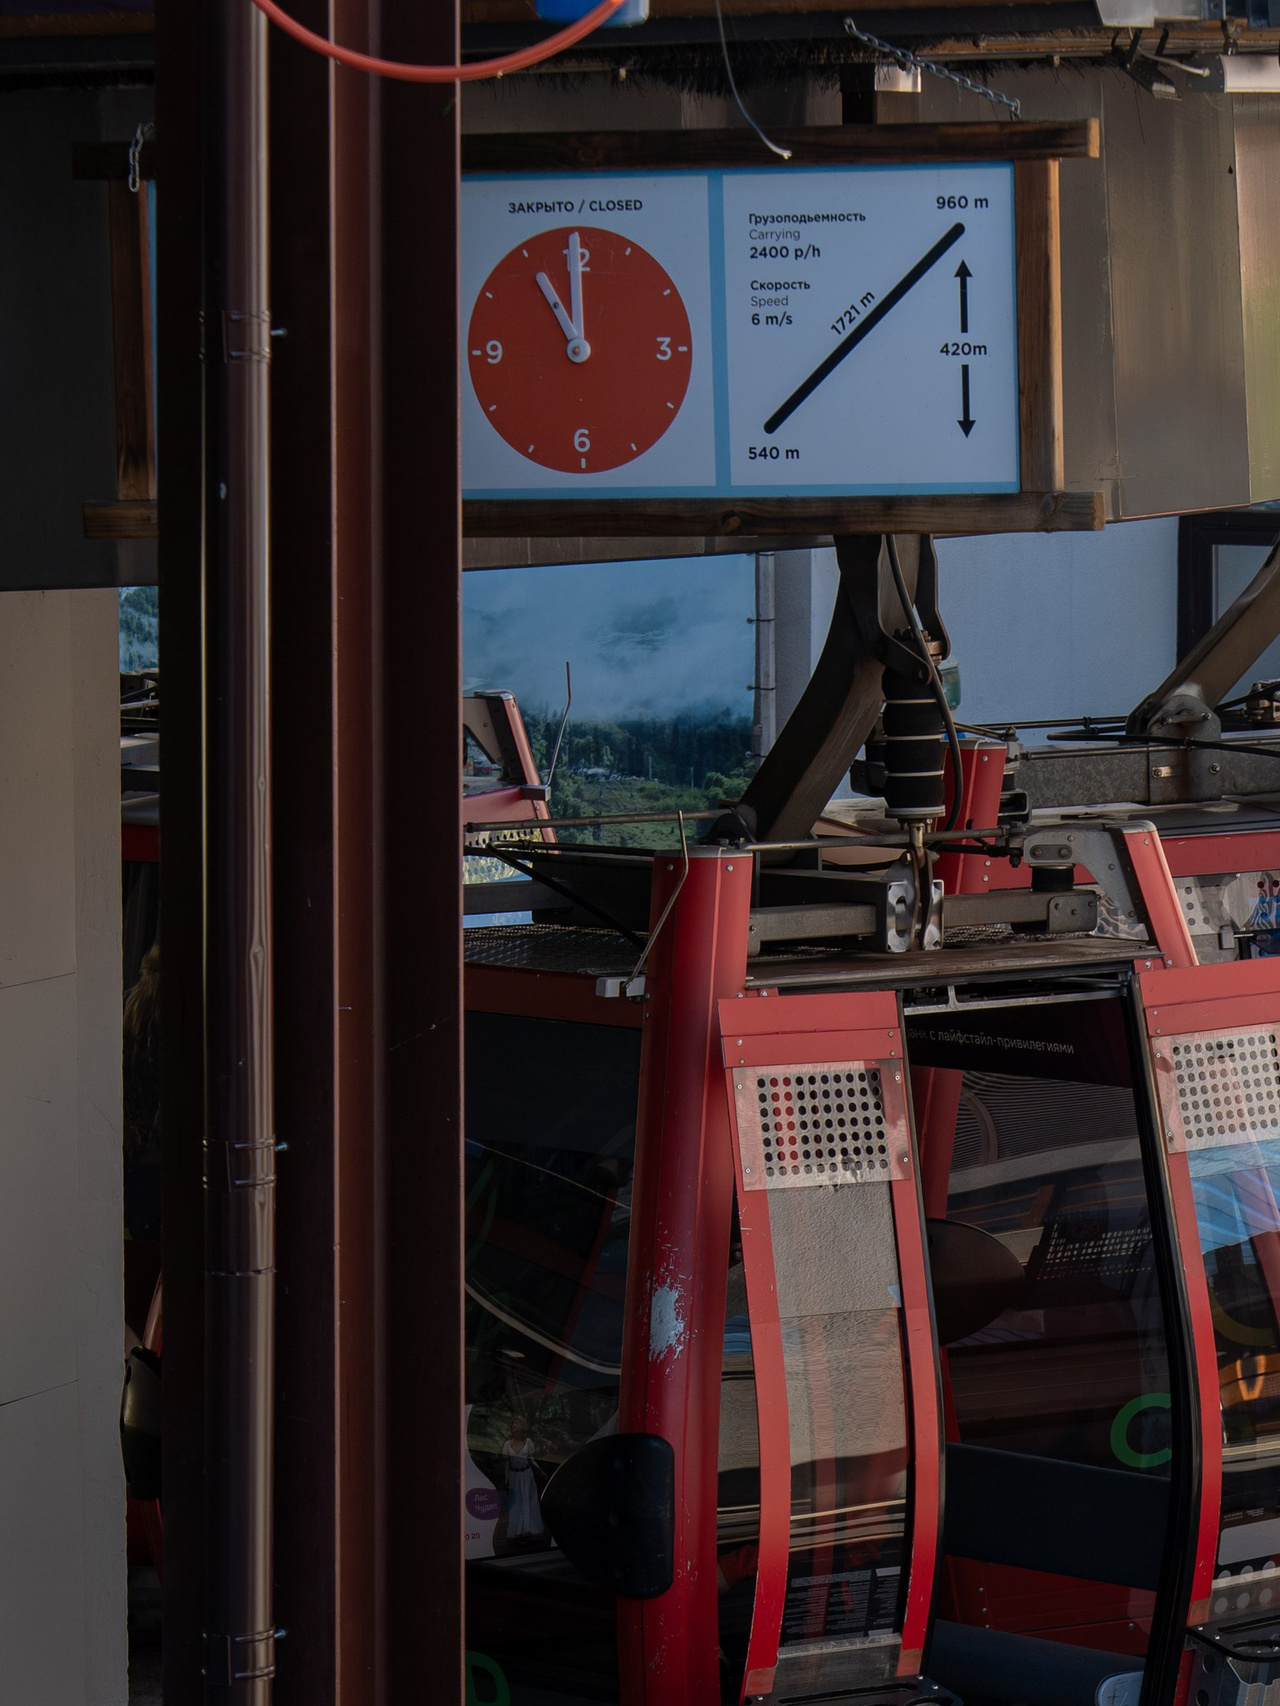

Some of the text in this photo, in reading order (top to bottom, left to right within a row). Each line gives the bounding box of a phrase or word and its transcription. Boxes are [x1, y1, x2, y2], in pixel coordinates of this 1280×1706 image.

[508, 199, 643, 214] ЗАКРЫТО / CLOSED
[936, 195, 989, 210] 960 m
[749, 228, 801, 242] Carrying
[749, 243, 821, 260] 2400 p/h
[750, 279, 811, 293] Скорость
[750, 295, 789, 309] Speed
[751, 311, 793, 327] 6 m/s
[830, 291, 875, 335] 1721 m
[485, 339, 503, 364] 9
[656, 336, 672, 361] 3
[939, 342, 988, 357] 420m
[573, 428, 591, 453] 6
[748, 446, 800, 461] 540 m
[938, 1028, 1075, 1056] лайфстайл-привилегиями
